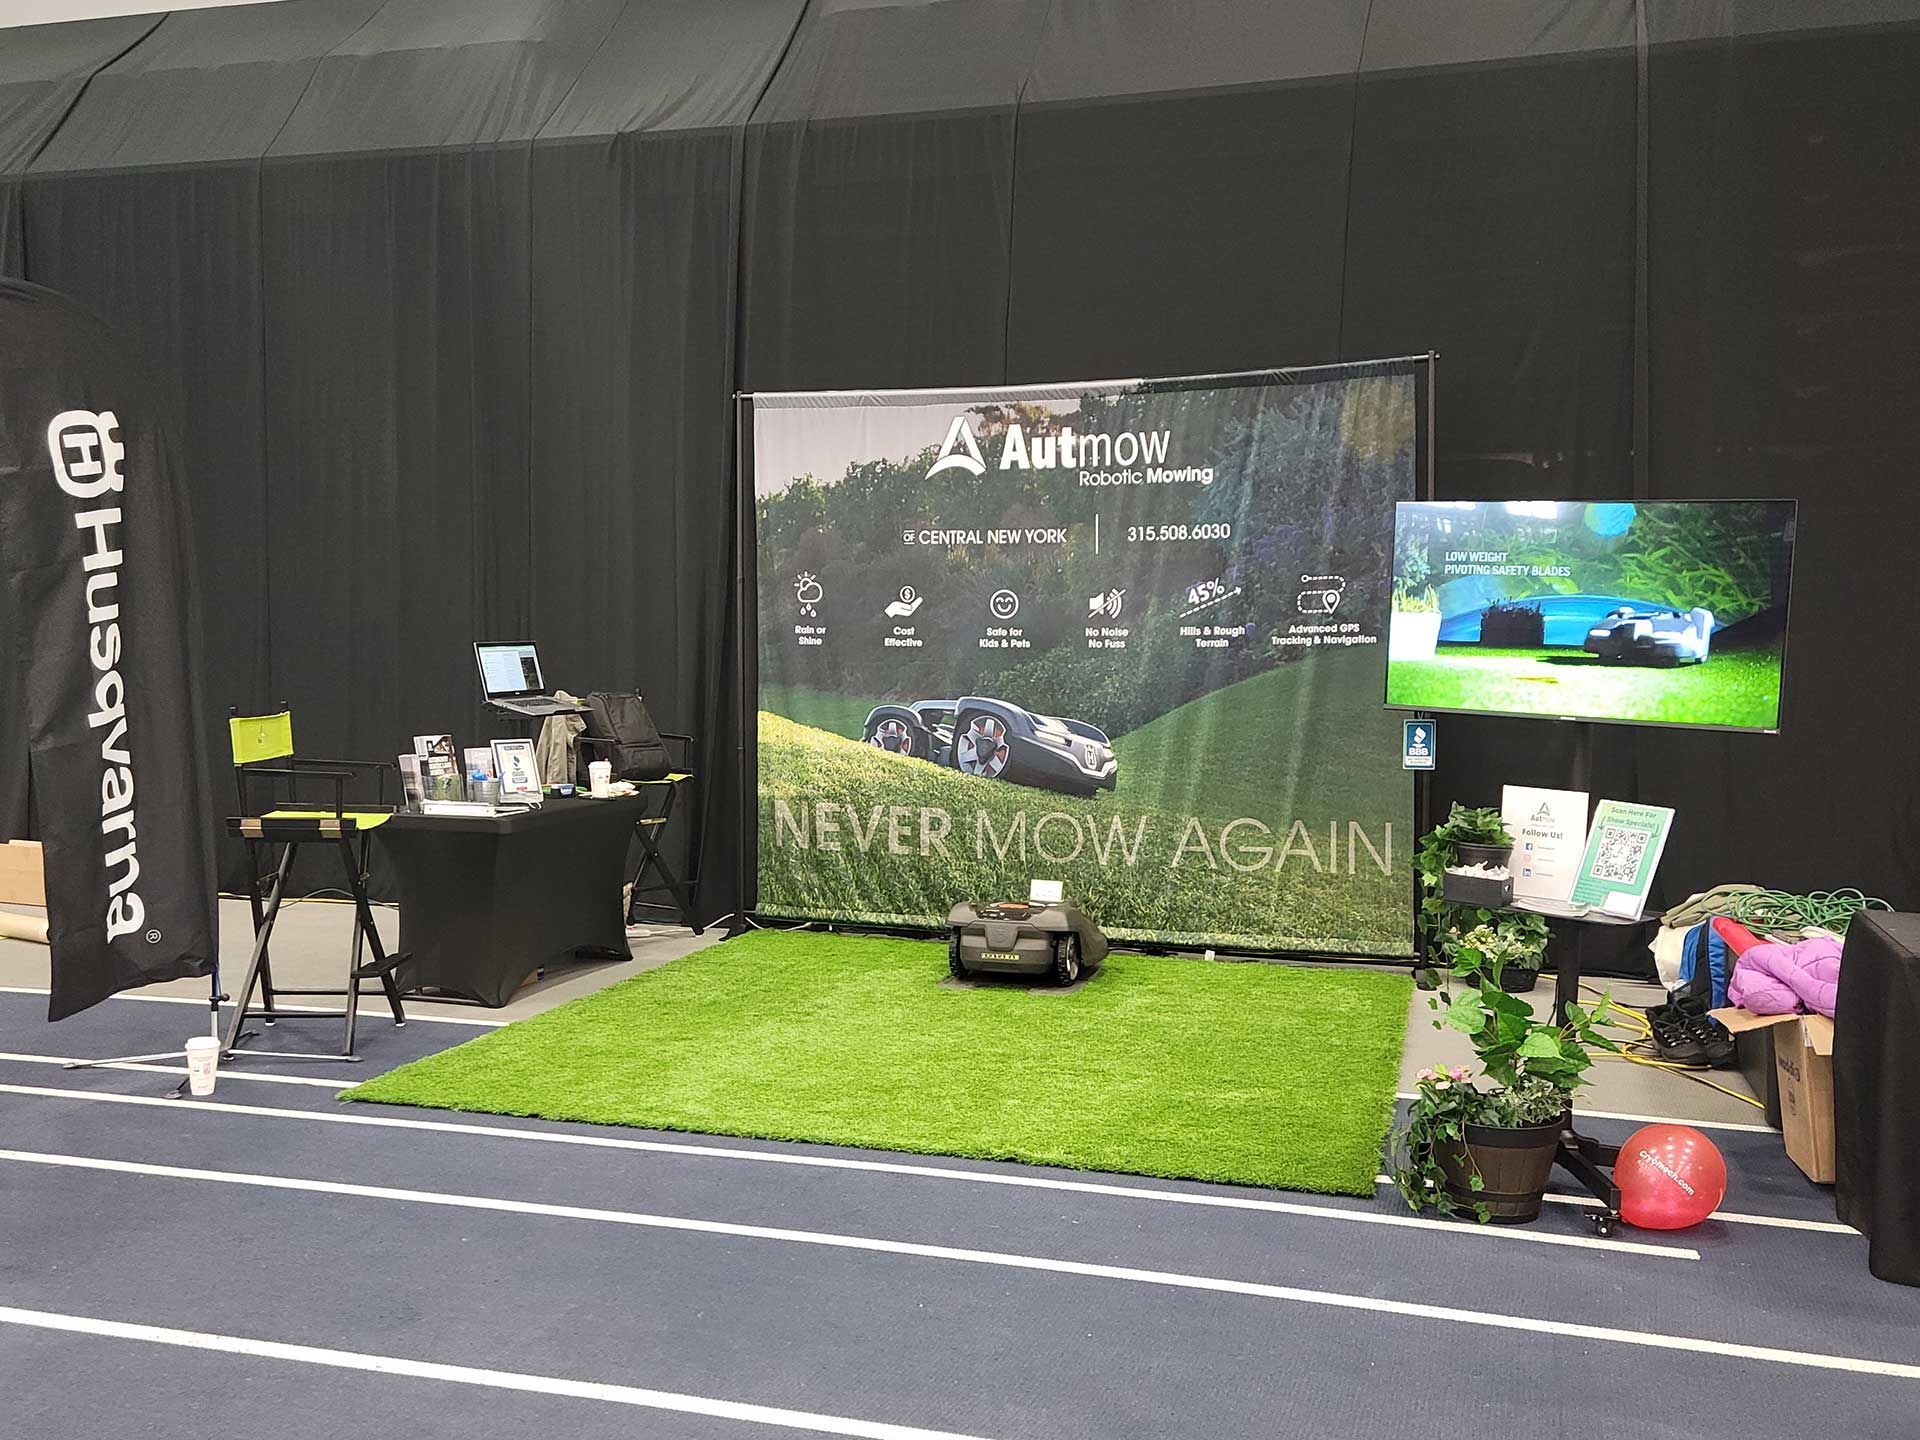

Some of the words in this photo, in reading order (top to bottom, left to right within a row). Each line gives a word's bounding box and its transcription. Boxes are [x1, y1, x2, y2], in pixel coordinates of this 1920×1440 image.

[999, 423, 1171, 470] Autmow
[1079, 469, 1144, 487] Robotic
[1146, 465, 1214, 486] Mowing
[903, 531, 915, 543] OF
[918, 529, 984, 546] CENTRAL
[987, 528, 1023, 545] NEW
[1024, 528, 1068, 544] YORK
[1127, 522, 1231, 543] 315.508.6030
[1445, 551, 1468, 562] LOW
[1469, 551, 1509, 562] WEIGHT
[1444, 564, 1490, 575] PIVOTING
[1491, 565, 1531, 576] SAFETY
[1532, 566, 1571, 577] BLADES
[1186, 577, 1226, 606] 45%
[795, 625, 816, 635] Rain
[816, 626, 826, 635] or
[893, 626, 915, 636] Cost
[986, 627, 1006, 637] Safe
[1007, 627, 1023, 637] for
[1085, 627, 1099, 637] No
[1101, 627, 1129, 637] Noise
[1180, 626, 1202, 636] Hills
[1203, 626, 1212, 636] &
[1213, 626, 1245, 637] Rough
[1288, 623, 1338, 635] Advanced
[1340, 623, 1360, 634] GPS
[799, 636, 823, 646] Shine
[884, 637, 923, 647] Effective
[979, 638, 999, 648] Kids
[1000, 638, 1009, 648] &
[1010, 638, 1031, 648] Pets
[1088, 638, 1103, 649] No
[1104, 638, 1126, 649] Fuss
[1195, 637, 1229, 648] Terrain
[1271, 635, 1312, 647] Tracking
[1313, 635, 1322, 645] &
[1323, 634, 1377, 646] Navigation
[74, 507, 145, 945] Husqvarna
[1408, 747, 1429, 757] BBB
[1611, 806, 1627, 815] Scan
[1627, 808, 1644, 817] Here
[1644, 811, 1657, 819] For
[773, 799, 951, 858] NEVER
[974, 809, 1148, 867] MOW
[1171, 816, 1393, 877] AGAIN
[1521, 828, 1549, 838] Follow
[1550, 830, 1563, 840] Us!
